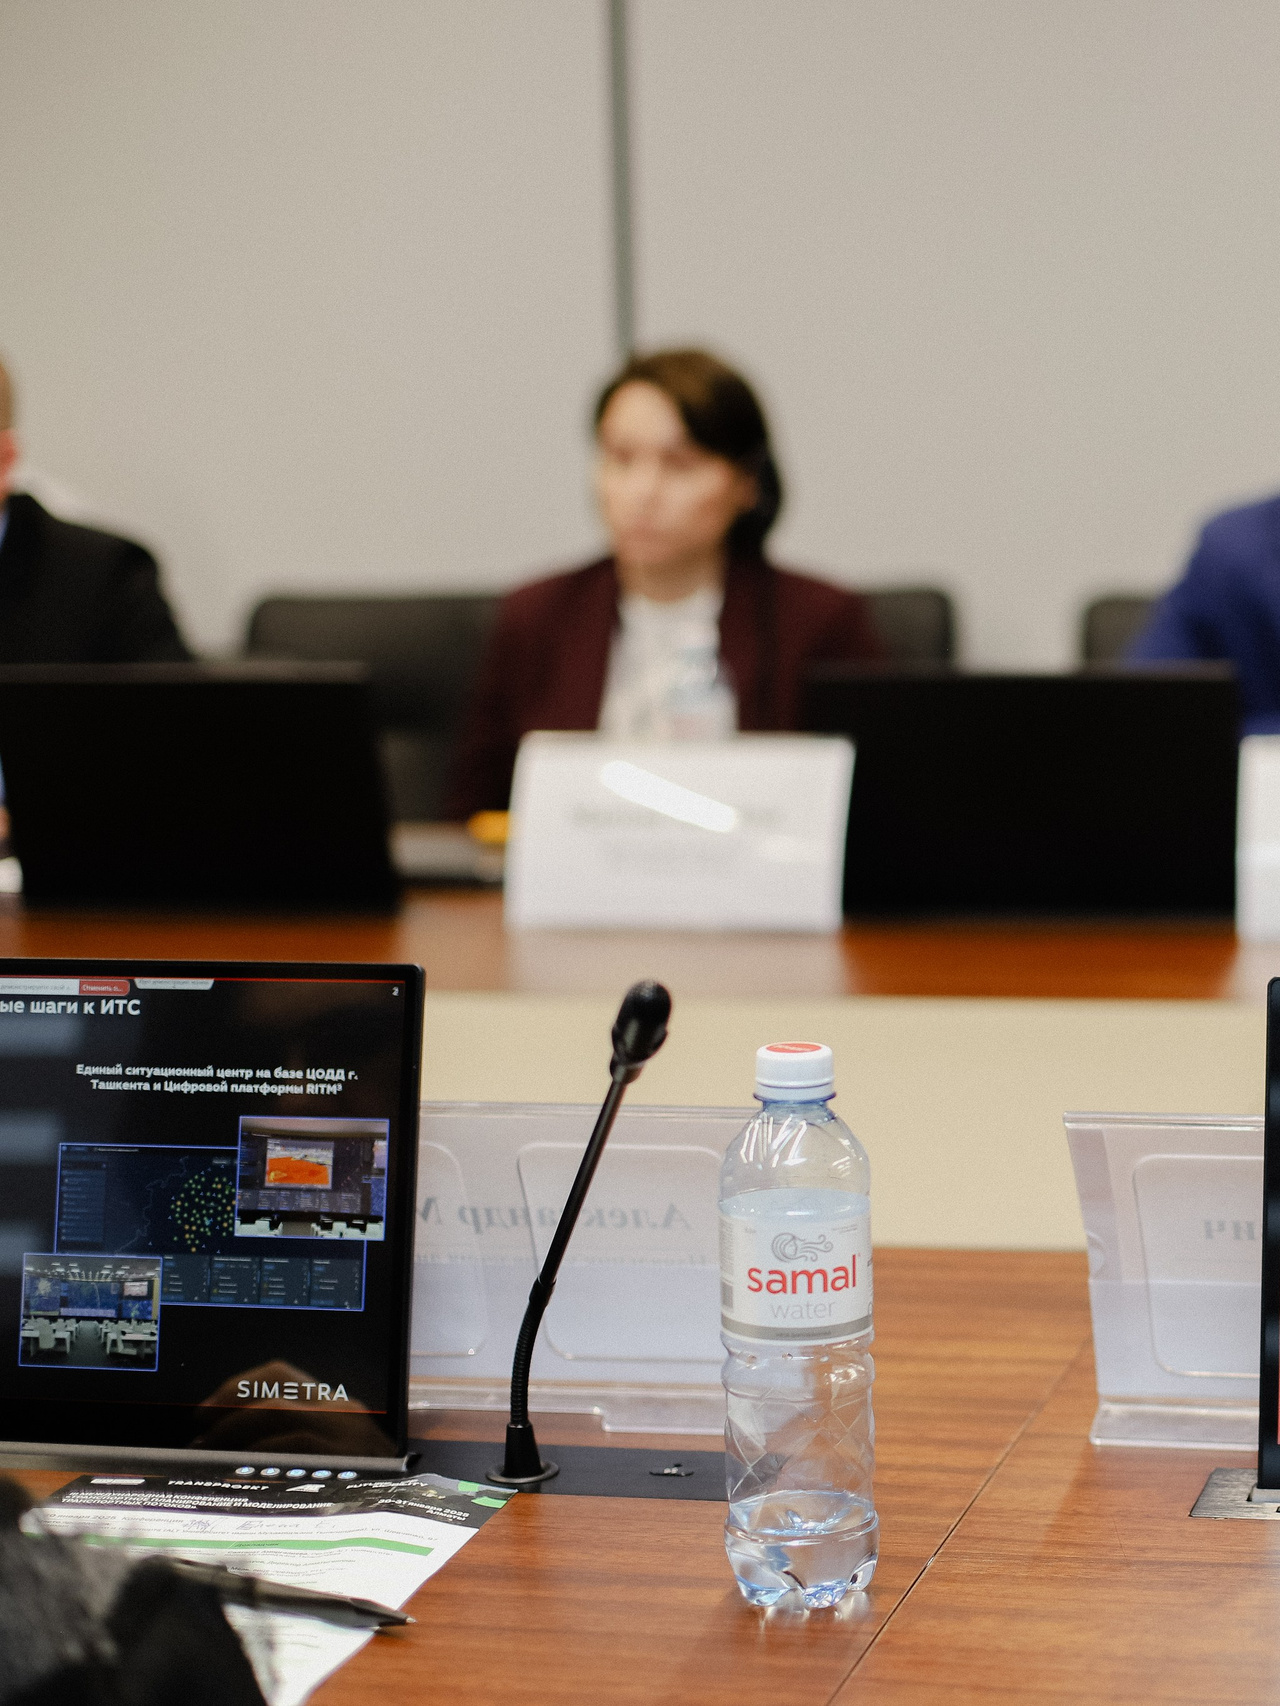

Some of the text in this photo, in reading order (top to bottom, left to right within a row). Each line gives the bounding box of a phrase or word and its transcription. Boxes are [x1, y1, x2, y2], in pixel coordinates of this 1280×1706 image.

[29, 1001, 79, 1014] шаги
[82, 1002, 95, 1014] к
[100, 999, 141, 1015] ИТС
[75, 1064, 123, 1076] Единый
[124, 1066, 214, 1078] ситуационный
[215, 1069, 254, 1080] центр
[255, 1069, 271, 1078] на
[273, 1067, 304, 1079] базе
[305, 1069, 346, 1081] ЦОДД
[89, 1079, 151, 1091] Ташкента
[152, 1082, 162, 1091] и
[163, 1081, 228, 1094] Цифровой
[229, 1083, 304, 1096] платформы
[747, 1253, 857, 1295] samal
[771, 1301, 837, 1321] water
[236, 1379, 350, 1403] SIMETRA
[426, 1509, 467, 1522] Алматы
